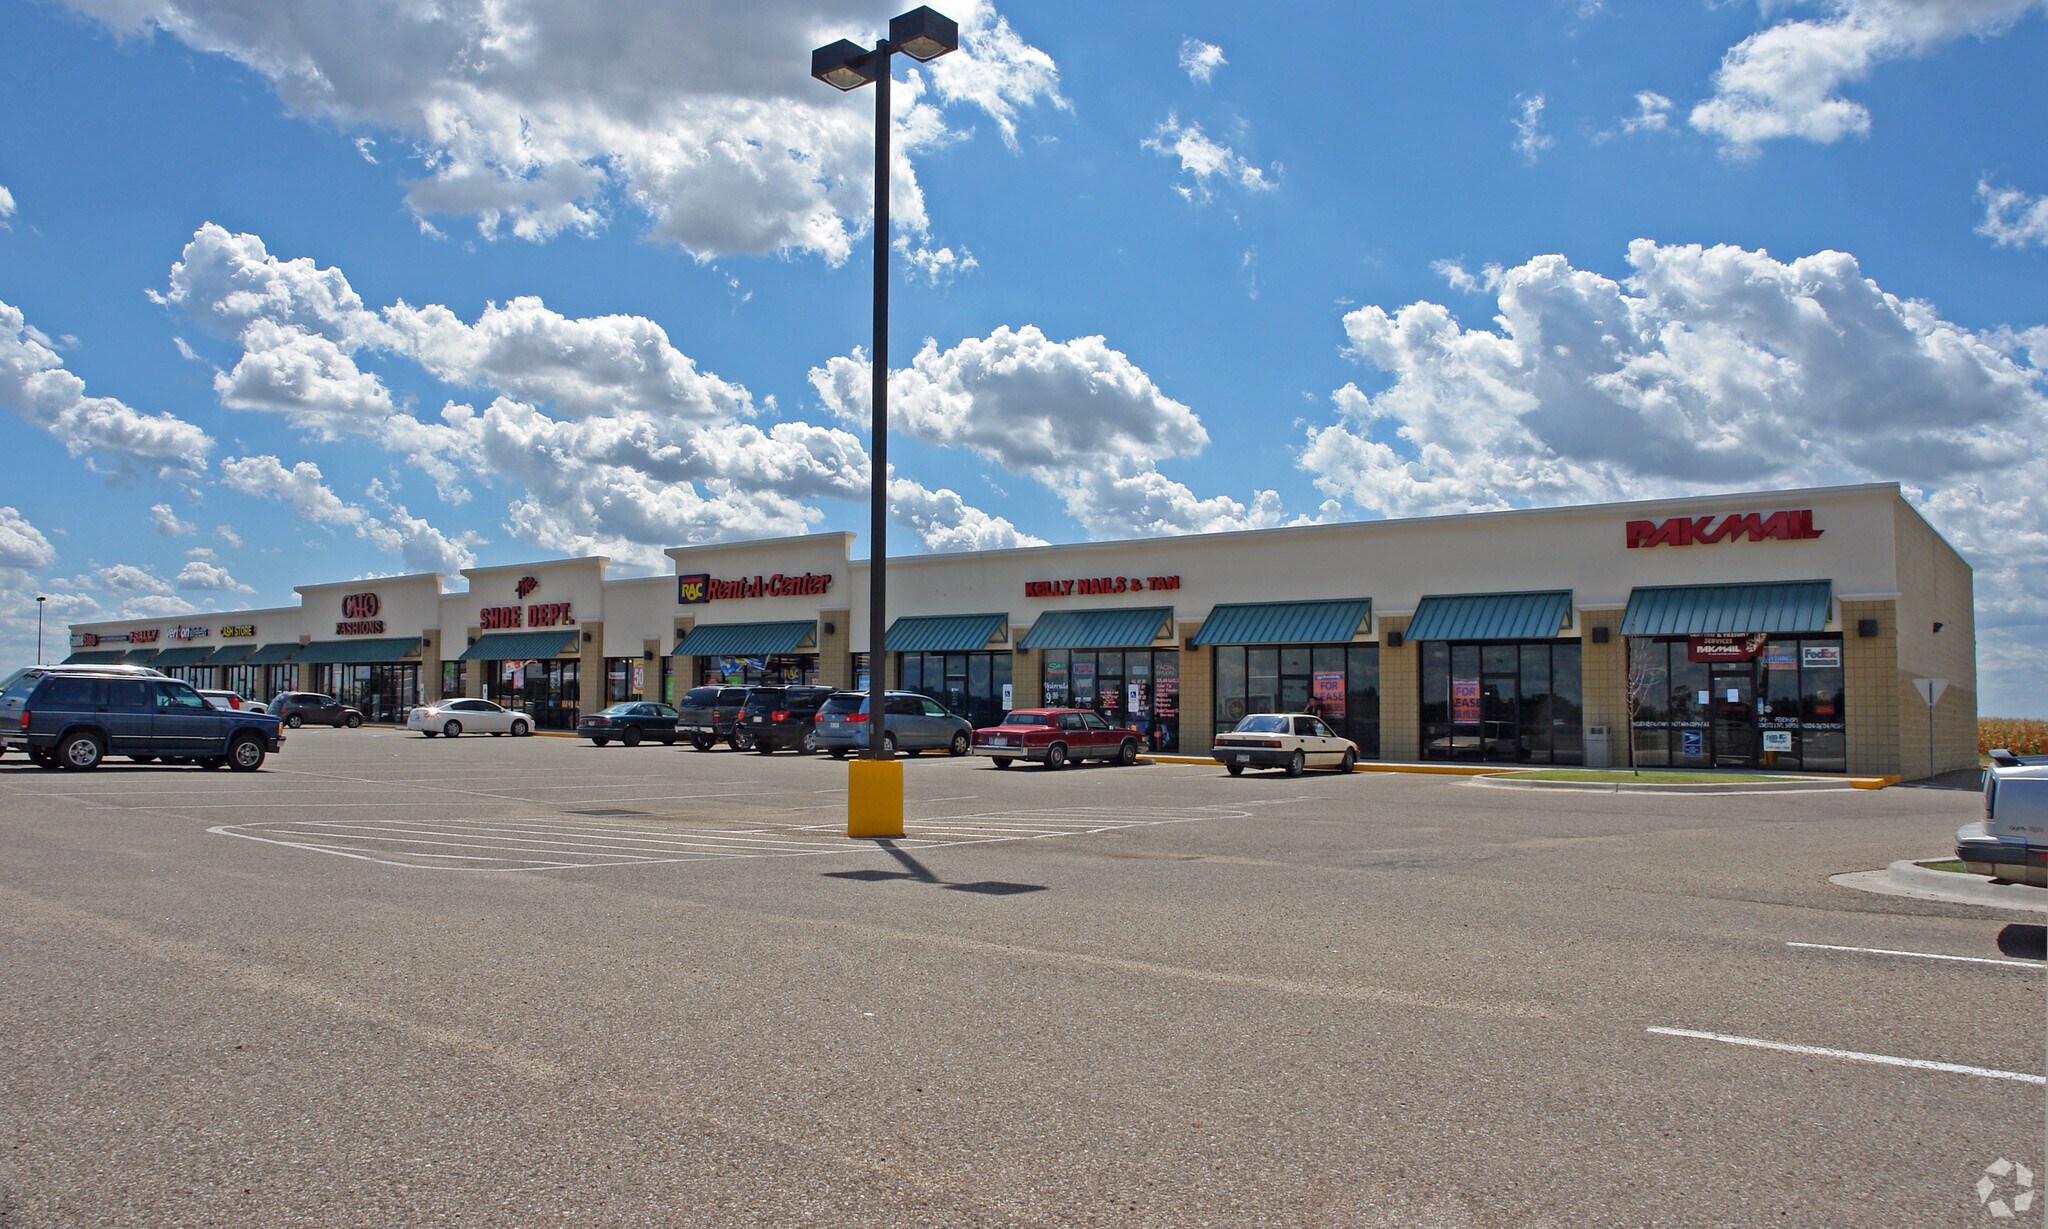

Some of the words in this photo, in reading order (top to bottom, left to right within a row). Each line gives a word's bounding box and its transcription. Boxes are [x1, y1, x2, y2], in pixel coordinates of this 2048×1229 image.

[681, 583, 703, 600] RAC
[1025, 580, 1074, 597] KELLY
[1078, 576, 1126, 595] NAILS
[1130, 578, 1142, 592] &
[1147, 575, 1180, 591] TAN
[480, 606, 521, 629] SHOE
[528, 603, 575, 627] DEPT.
[221, 626, 234, 637] CASH
[234, 625, 254, 636] STORE
[336, 621, 384, 635] FASHIONS
[1805, 649, 1837, 659] FedEx
[1320, 681, 1338, 690] FOR
[1456, 687, 1476, 696] FOR
[1454, 698, 1481, 707] EASE
